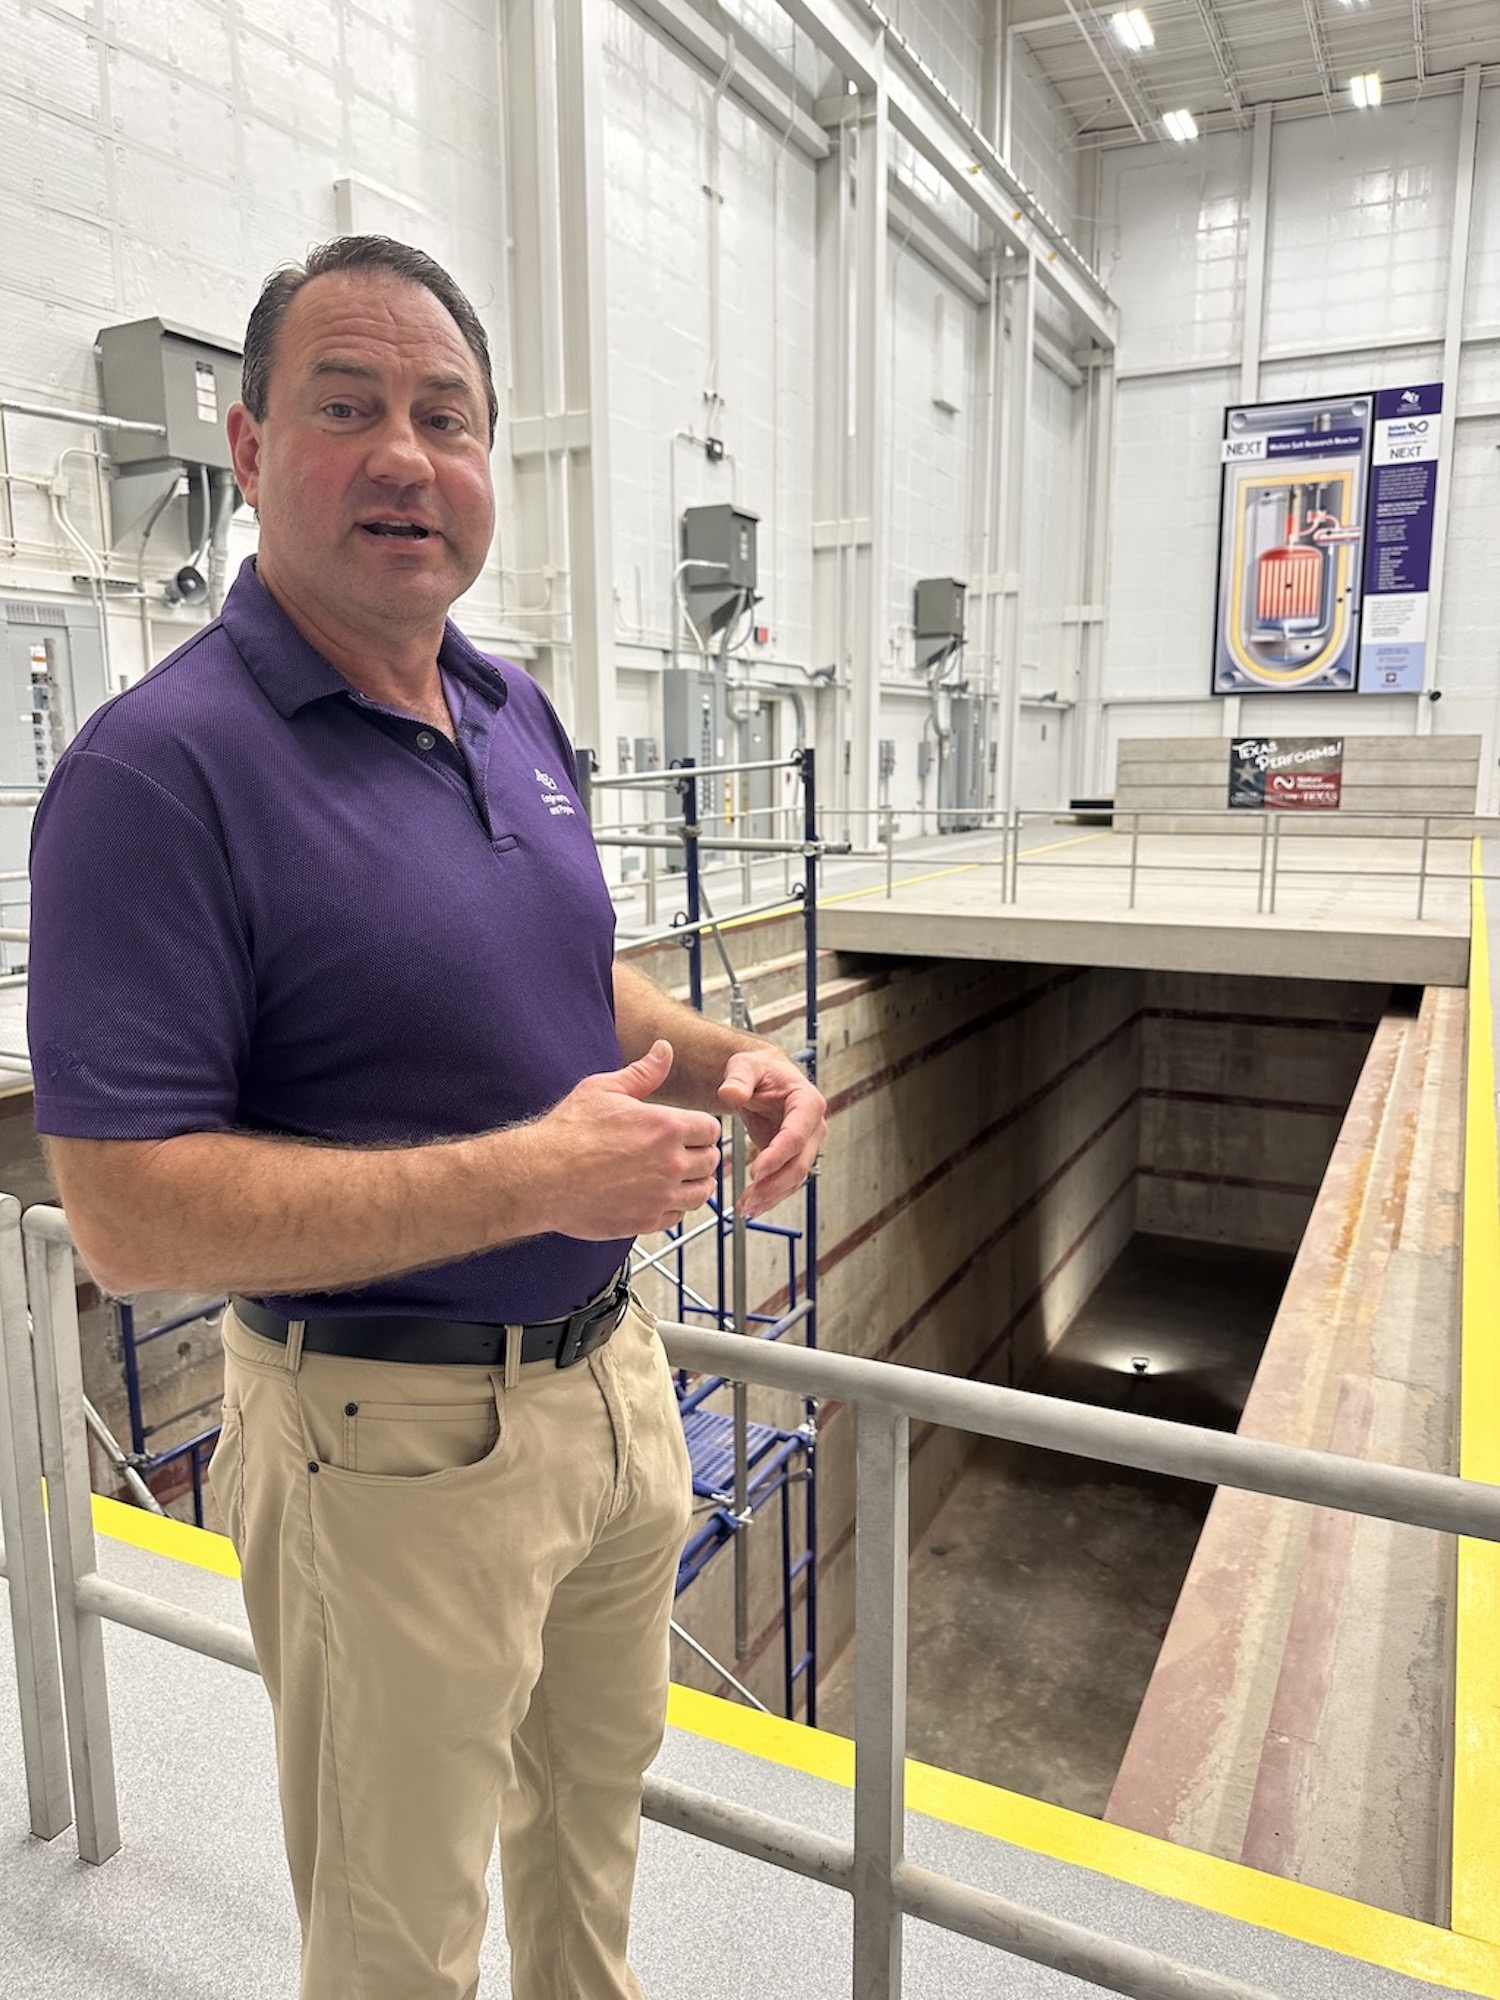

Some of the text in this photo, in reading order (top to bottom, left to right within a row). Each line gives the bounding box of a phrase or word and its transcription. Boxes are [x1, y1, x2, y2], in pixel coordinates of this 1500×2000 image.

[1226, 441, 1262, 457] NEXT
[1305, 438, 1334, 448] Research
[1334, 435, 1360, 445] Reactor
[1390, 445, 1422, 459] NEXT
